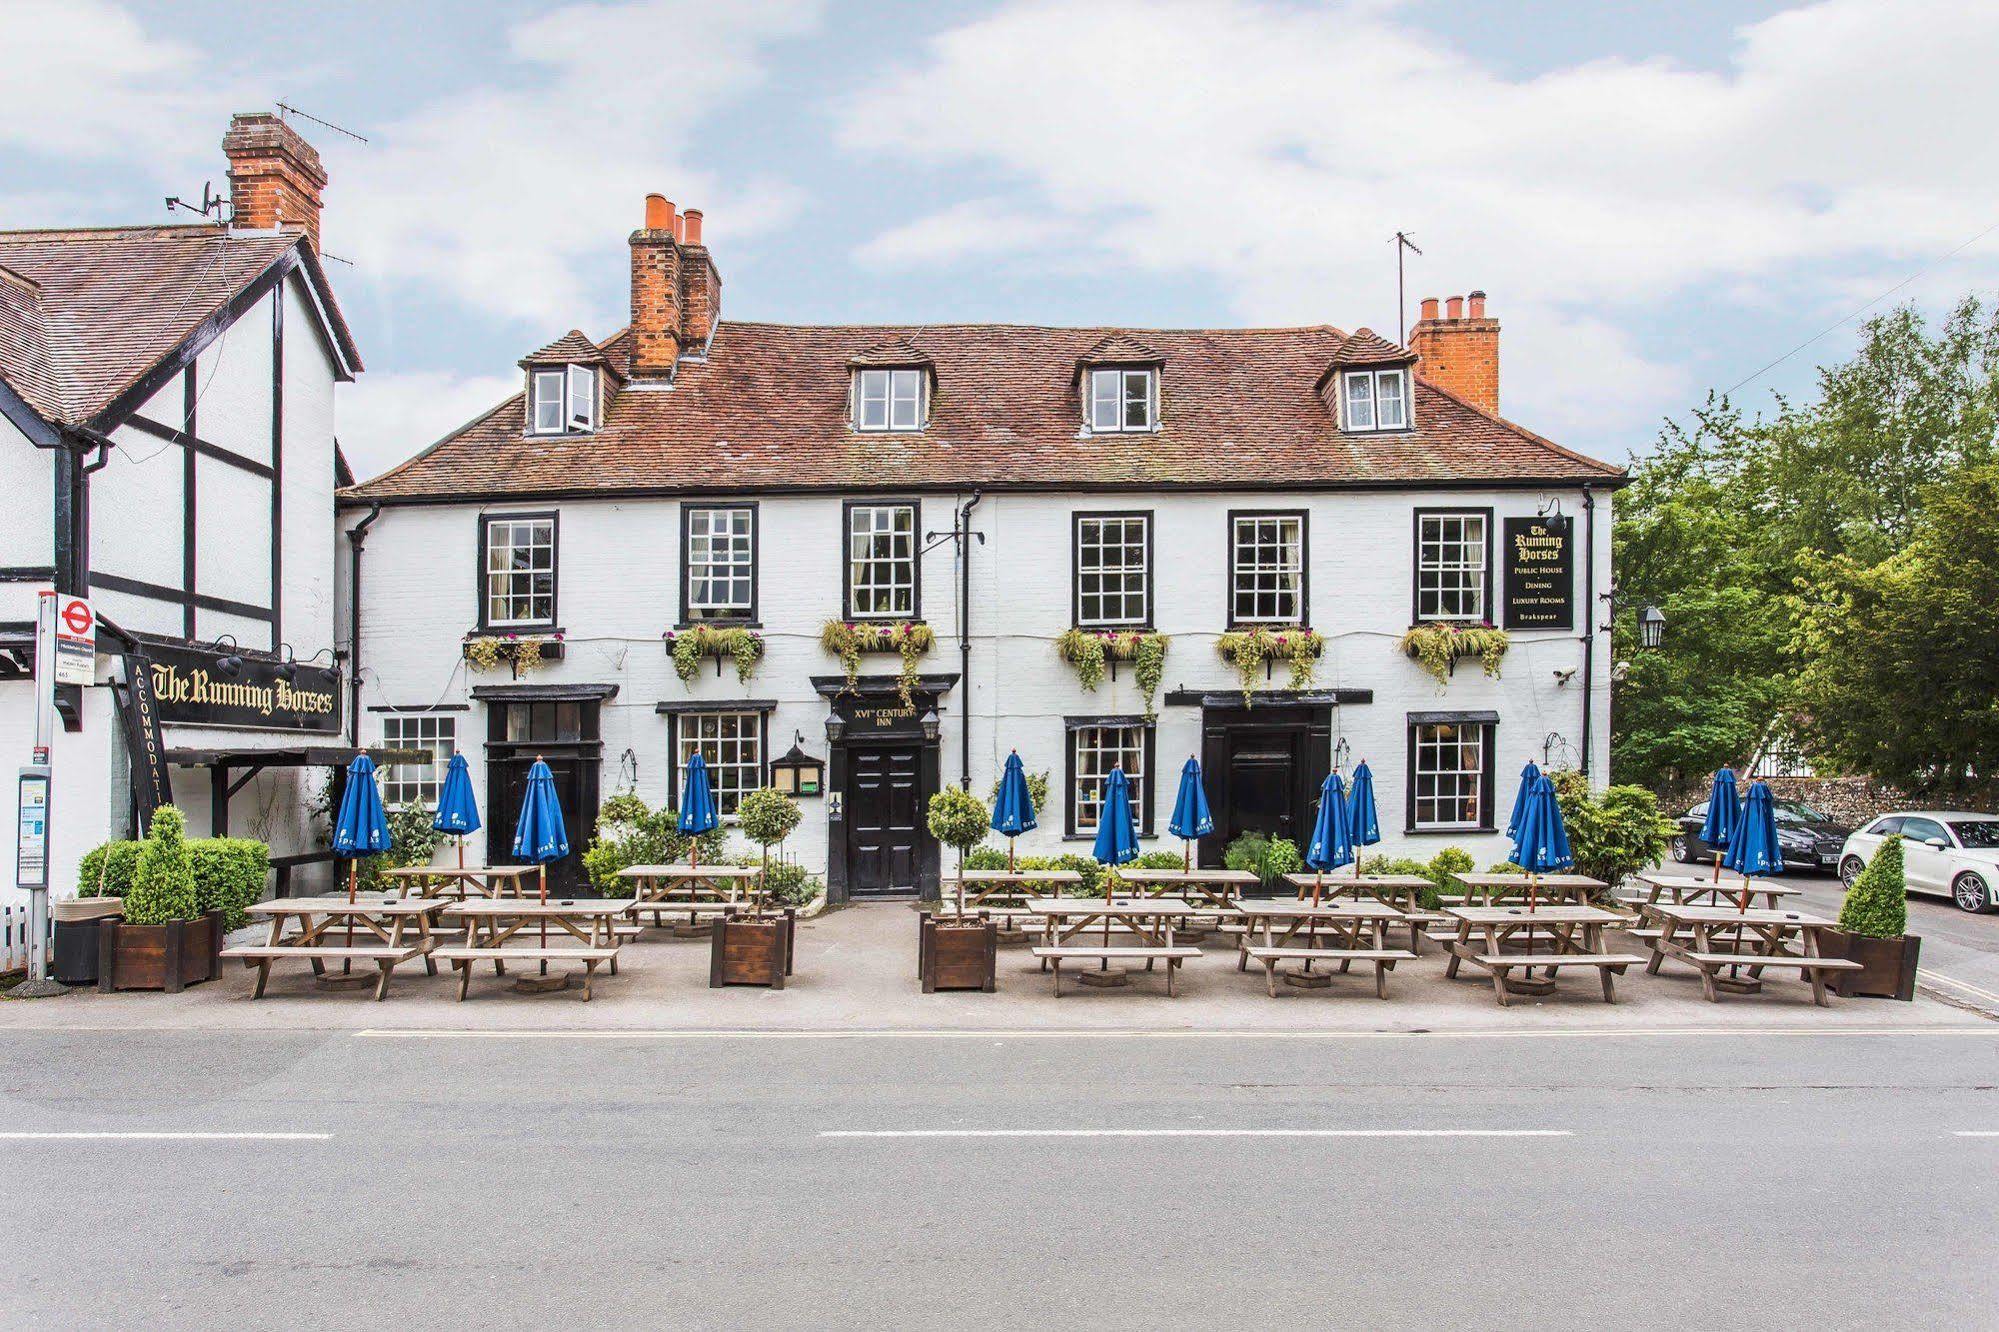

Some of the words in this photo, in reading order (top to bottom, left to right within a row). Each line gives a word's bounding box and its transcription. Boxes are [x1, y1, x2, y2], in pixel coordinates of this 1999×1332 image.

[1530, 526, 1547, 536] The
[1515, 534, 1563, 549] Running
[1519, 548, 1559, 562] Horses
[150, 663, 190, 705] The
[190, 668, 274, 717] Running
[275, 678, 333, 714] Horses
[876, 708, 914, 718] CENTURY
[876, 717, 892, 727] INN
[135, 664, 161, 803] ACCOMMODATI
